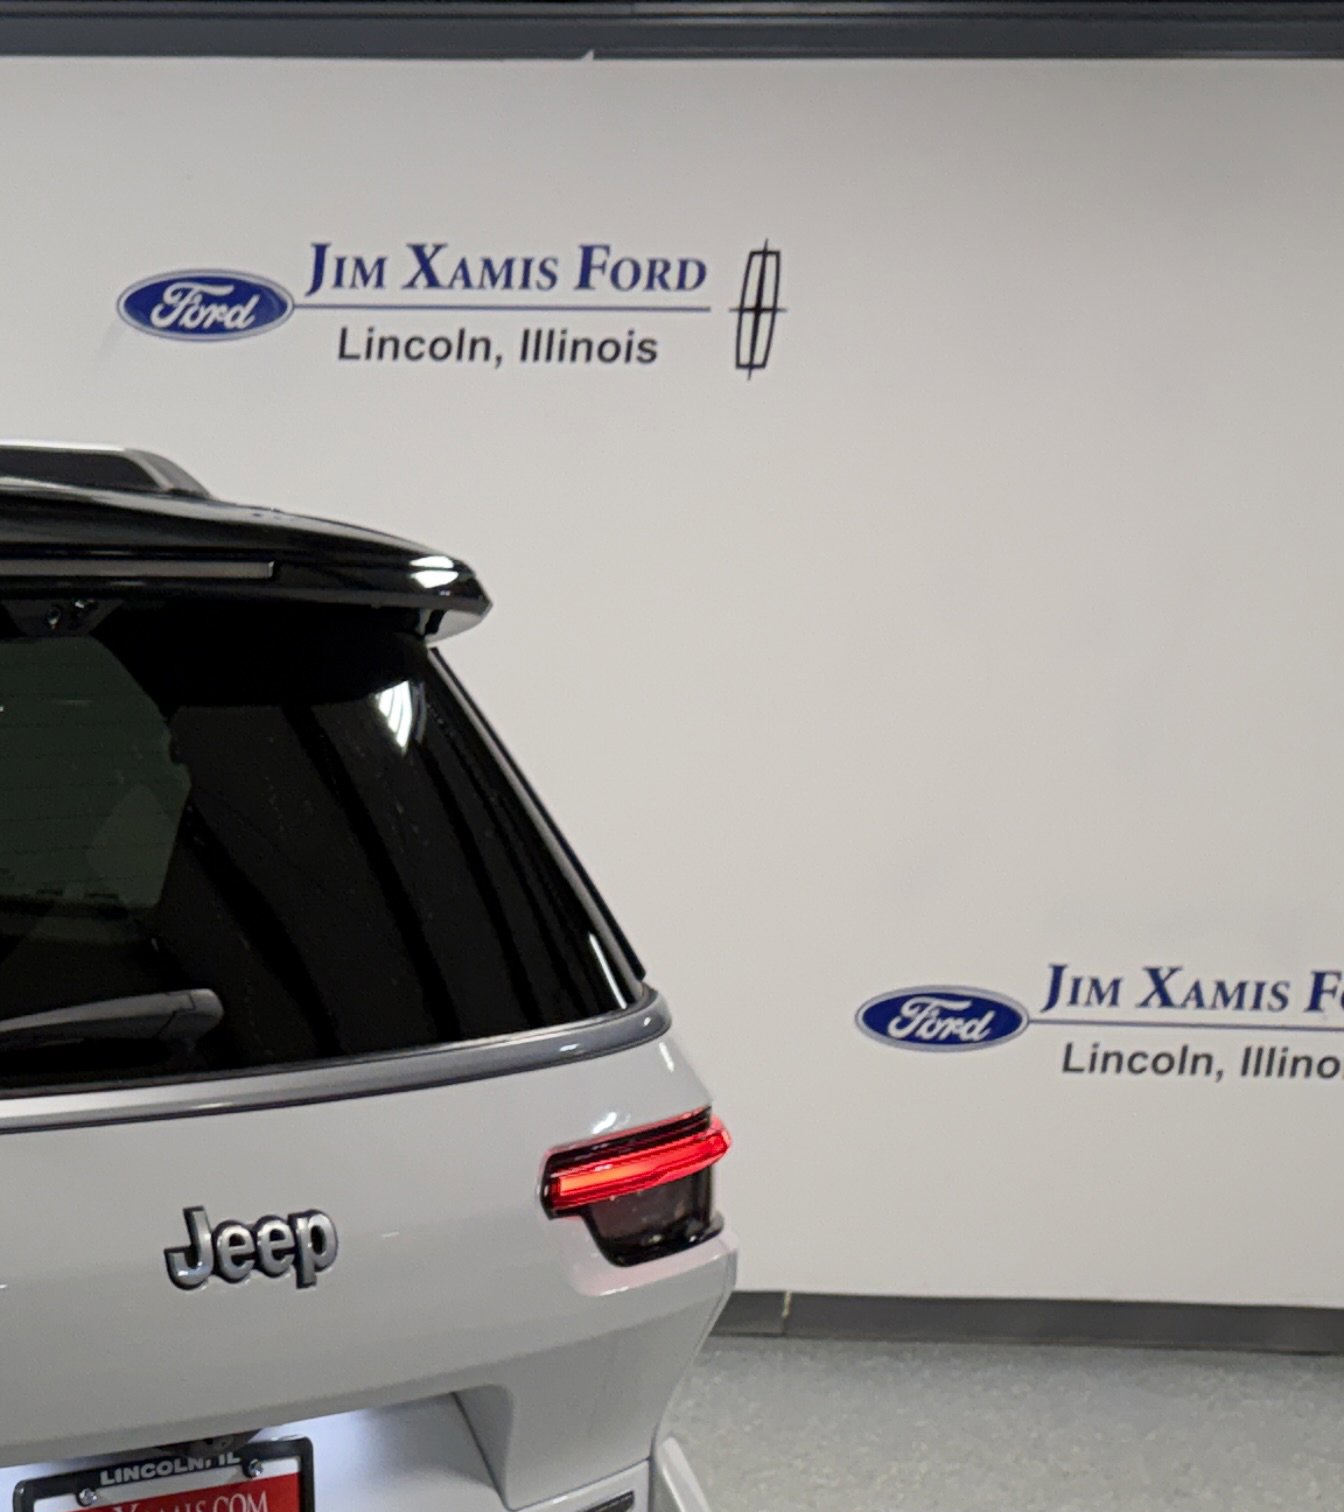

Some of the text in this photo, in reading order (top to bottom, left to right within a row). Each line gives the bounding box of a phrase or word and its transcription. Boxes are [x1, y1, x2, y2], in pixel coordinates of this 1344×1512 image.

[305, 242, 707, 297] JIM XAMIS FORD
[150, 282, 258, 330] Ford
[338, 327, 659, 370] Lincoln, Illinois
[1039, 963, 1123, 1014] JIM
[1135, 965, 1290, 1013] XAMIS
[887, 997, 994, 1042] Ford
[1061, 1043, 1225, 1083] Lincoln,
[164, 1205, 338, 1290] Jeep
